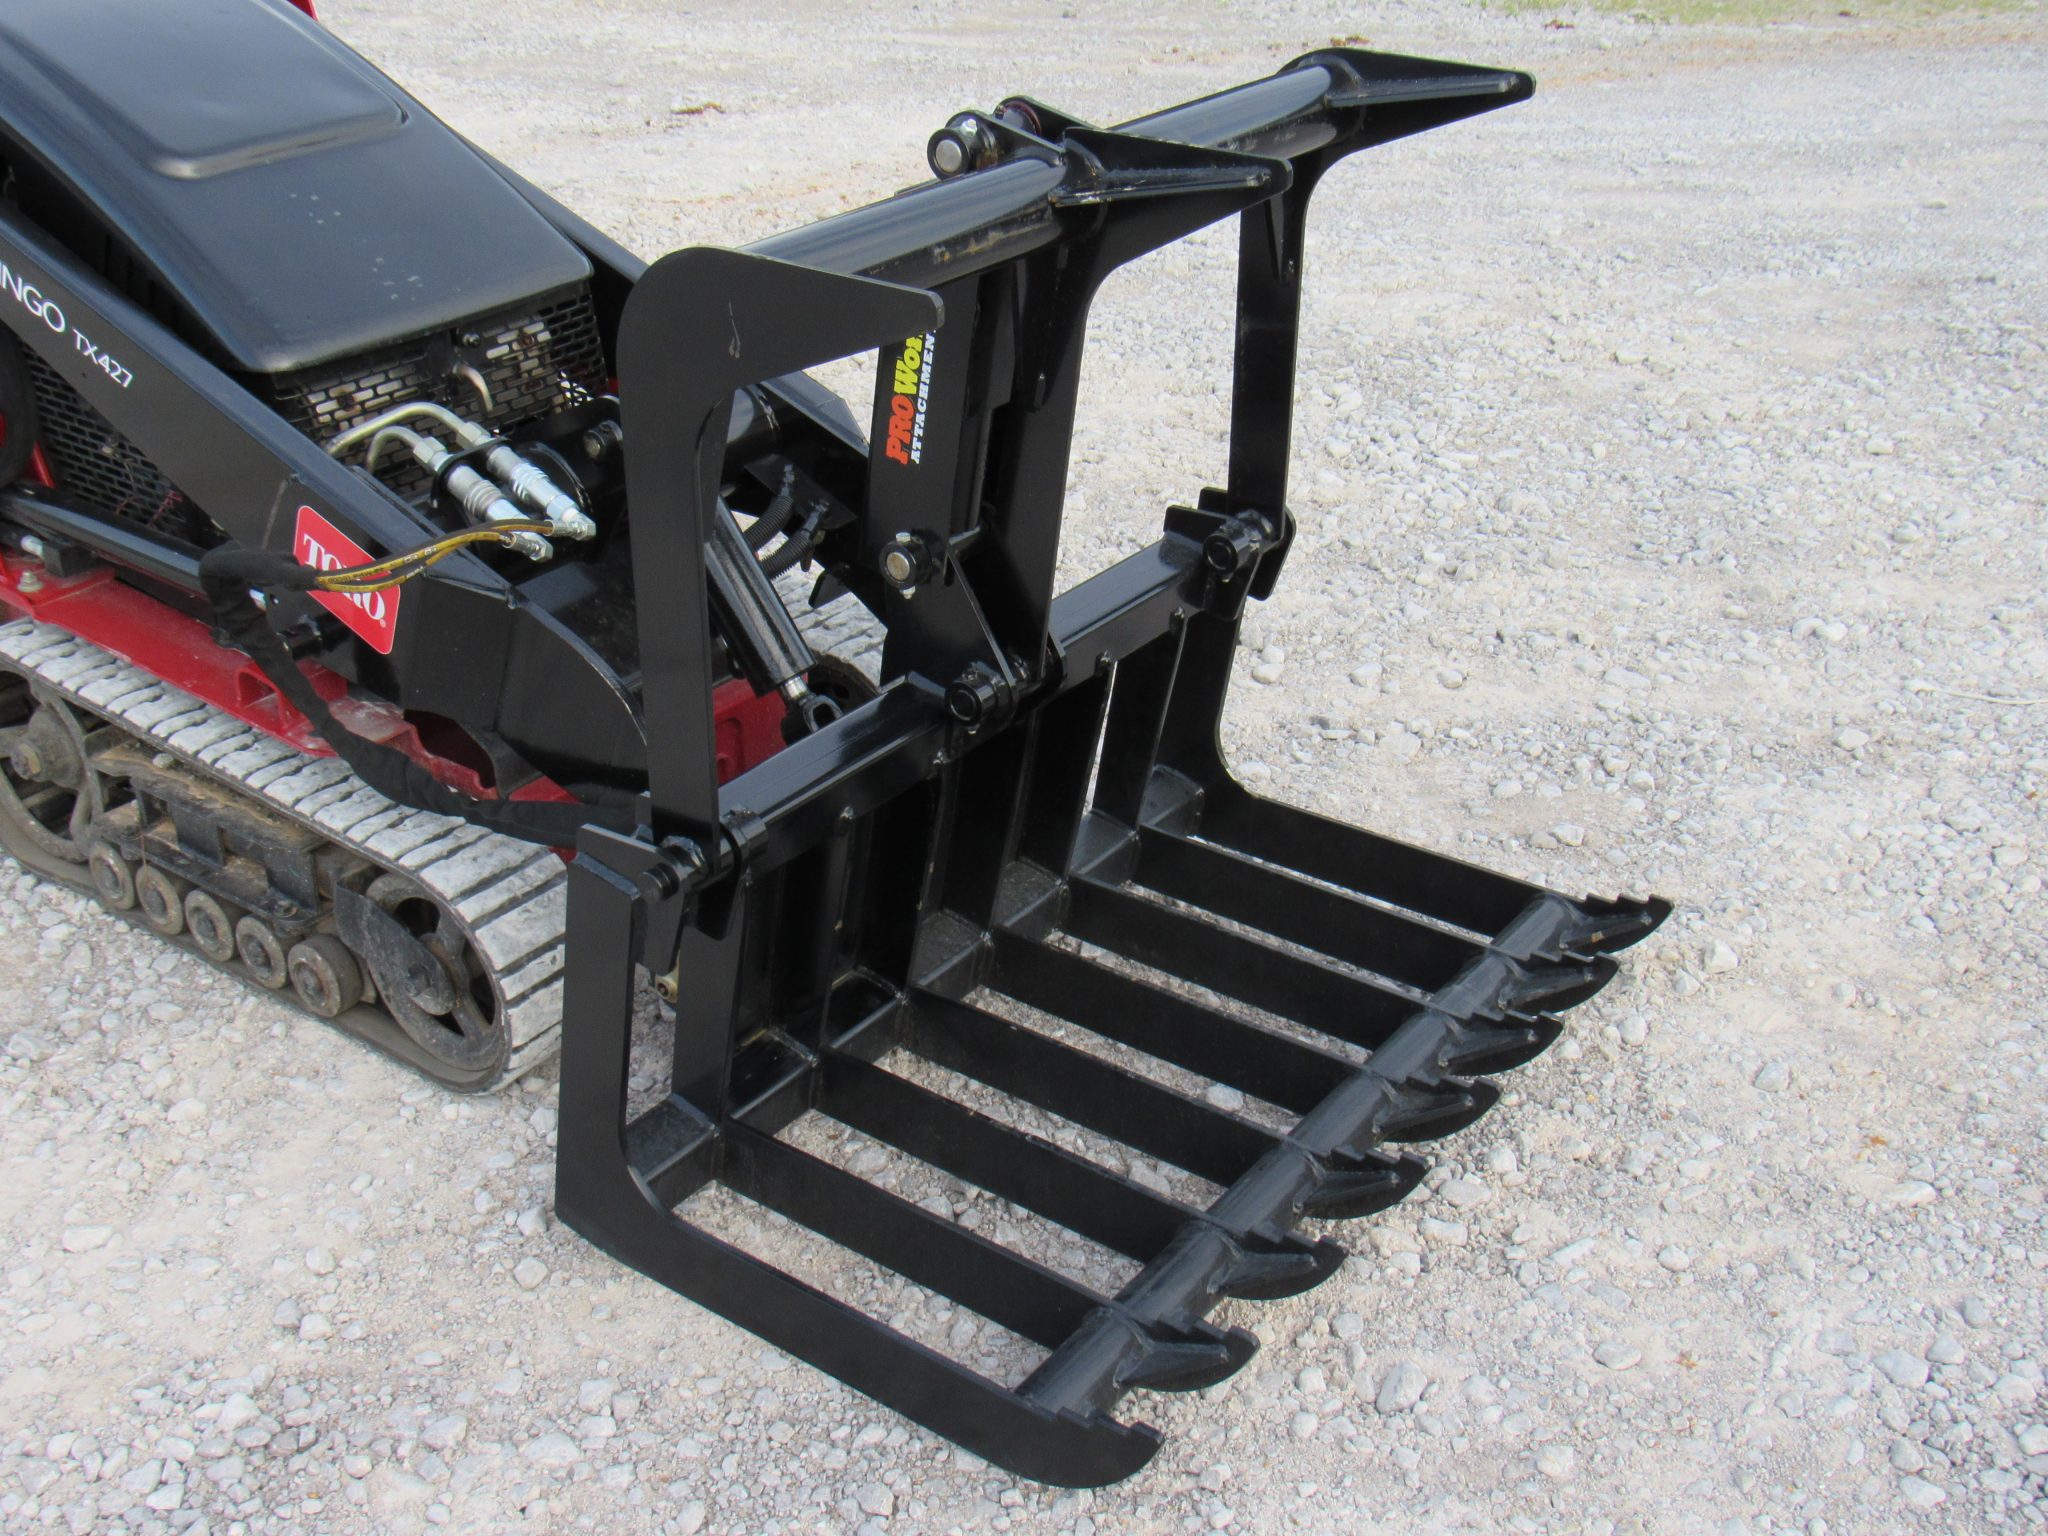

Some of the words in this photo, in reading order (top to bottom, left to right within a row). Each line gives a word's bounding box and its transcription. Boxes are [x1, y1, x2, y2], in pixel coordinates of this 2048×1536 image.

[72, 326, 134, 388] TX427
[885, 394, 914, 465] PRO
[911, 329, 937, 465] ATTACHMEN
